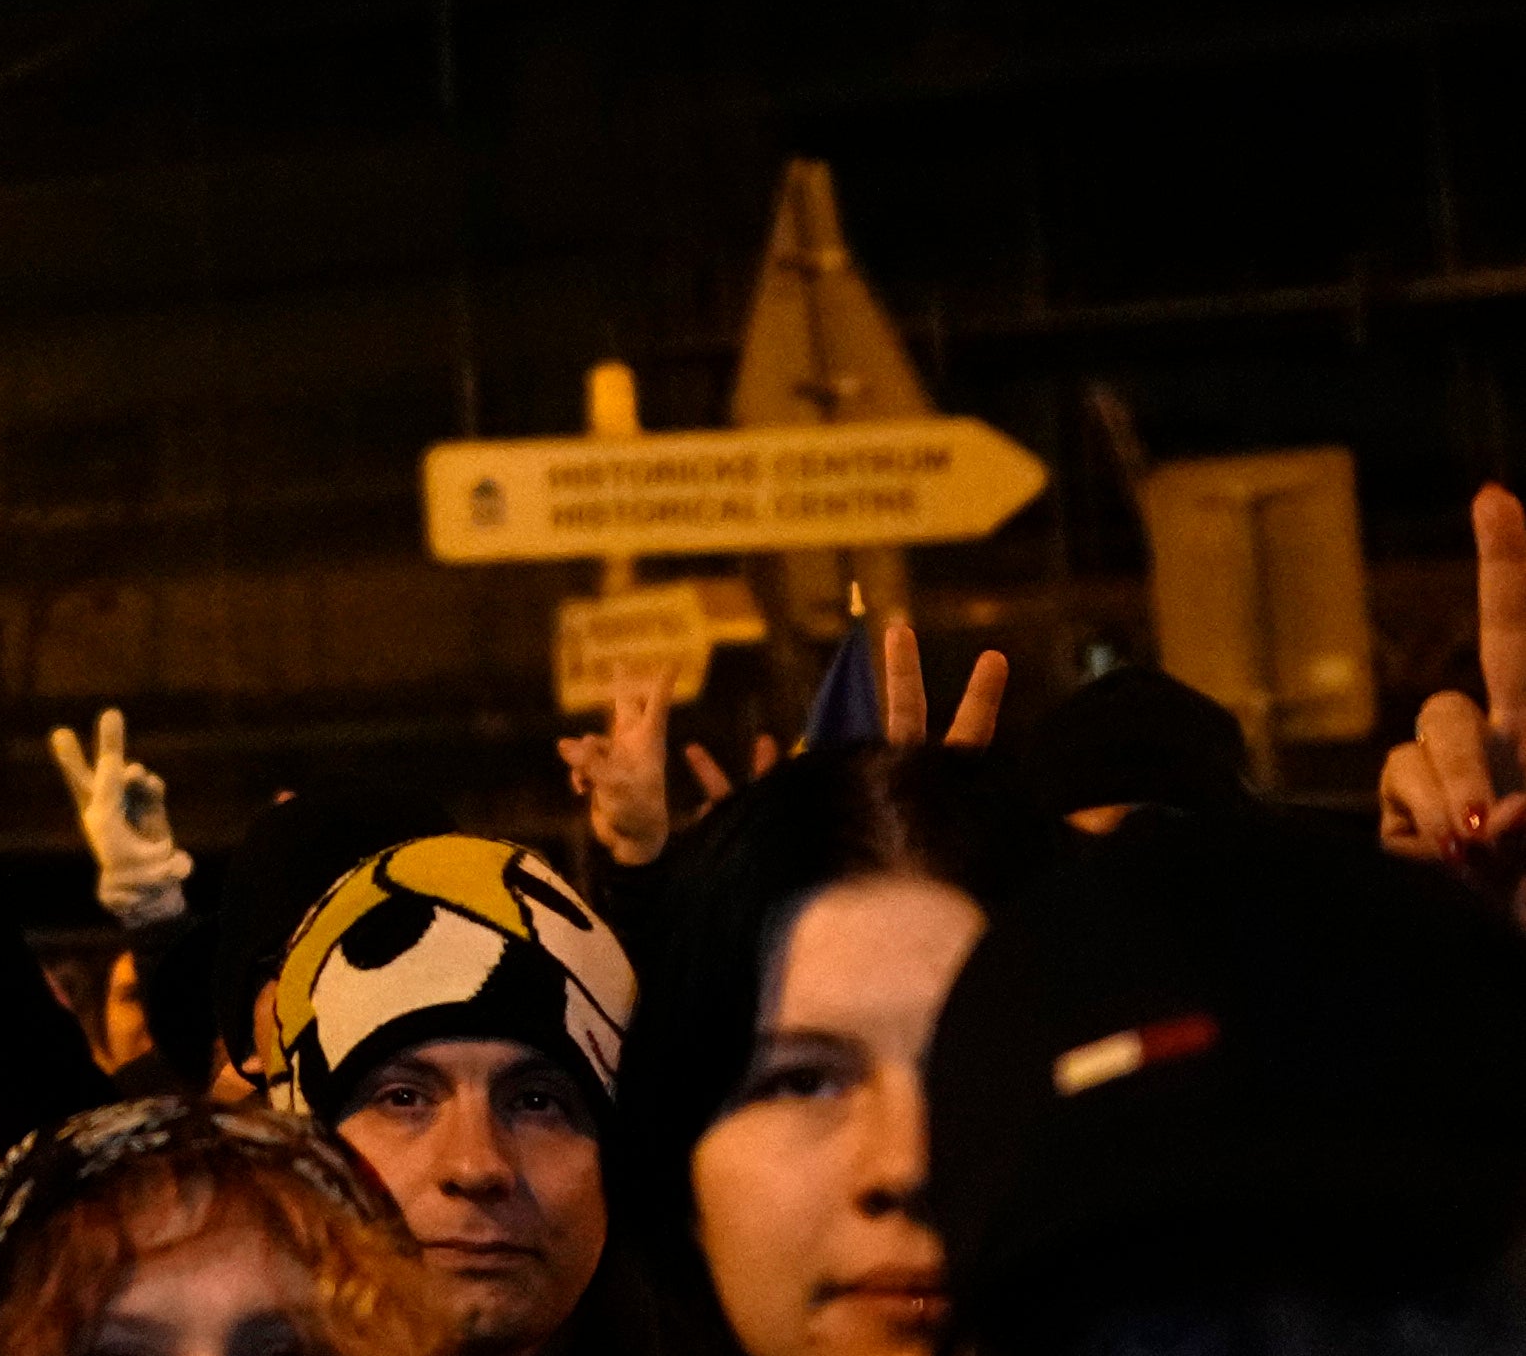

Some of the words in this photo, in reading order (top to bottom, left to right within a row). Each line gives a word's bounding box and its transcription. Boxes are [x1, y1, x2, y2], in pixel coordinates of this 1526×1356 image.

[772, 445, 951, 478] CENTRUM
[549, 494, 757, 531] HISTORICAL
[773, 484, 920, 520] CENTRE
